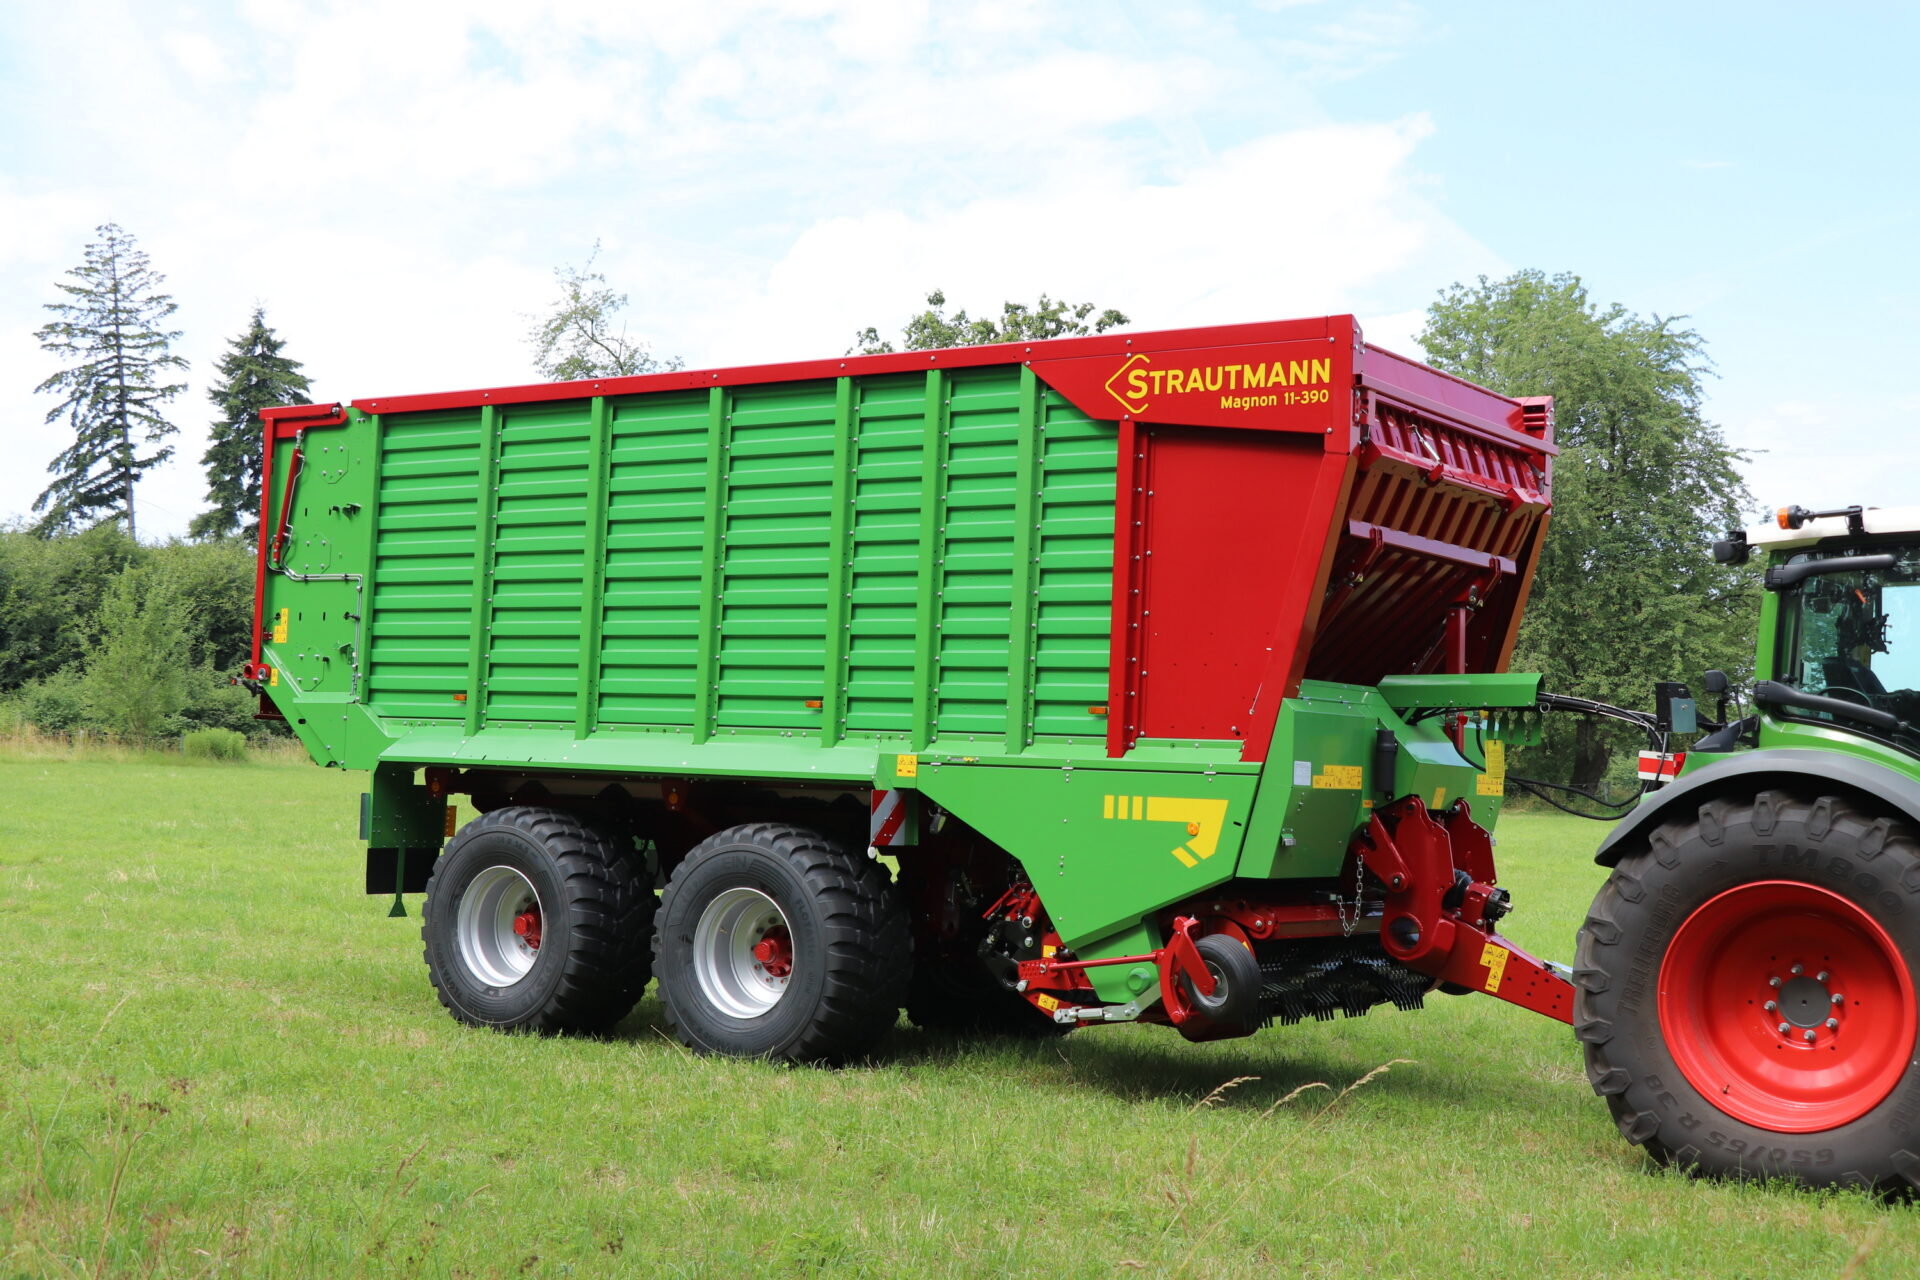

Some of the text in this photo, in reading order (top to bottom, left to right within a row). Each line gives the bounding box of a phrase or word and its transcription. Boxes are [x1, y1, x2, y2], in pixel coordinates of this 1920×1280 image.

[1126, 358, 1331, 400] STRAUTMANN
[1220, 389, 1329, 411] Magnon 11-390
[1617, 883, 1681, 1017] TRELLEBORG
[1677, 1112, 1703, 1130] R
[1704, 1130, 1835, 1168] 650/65
